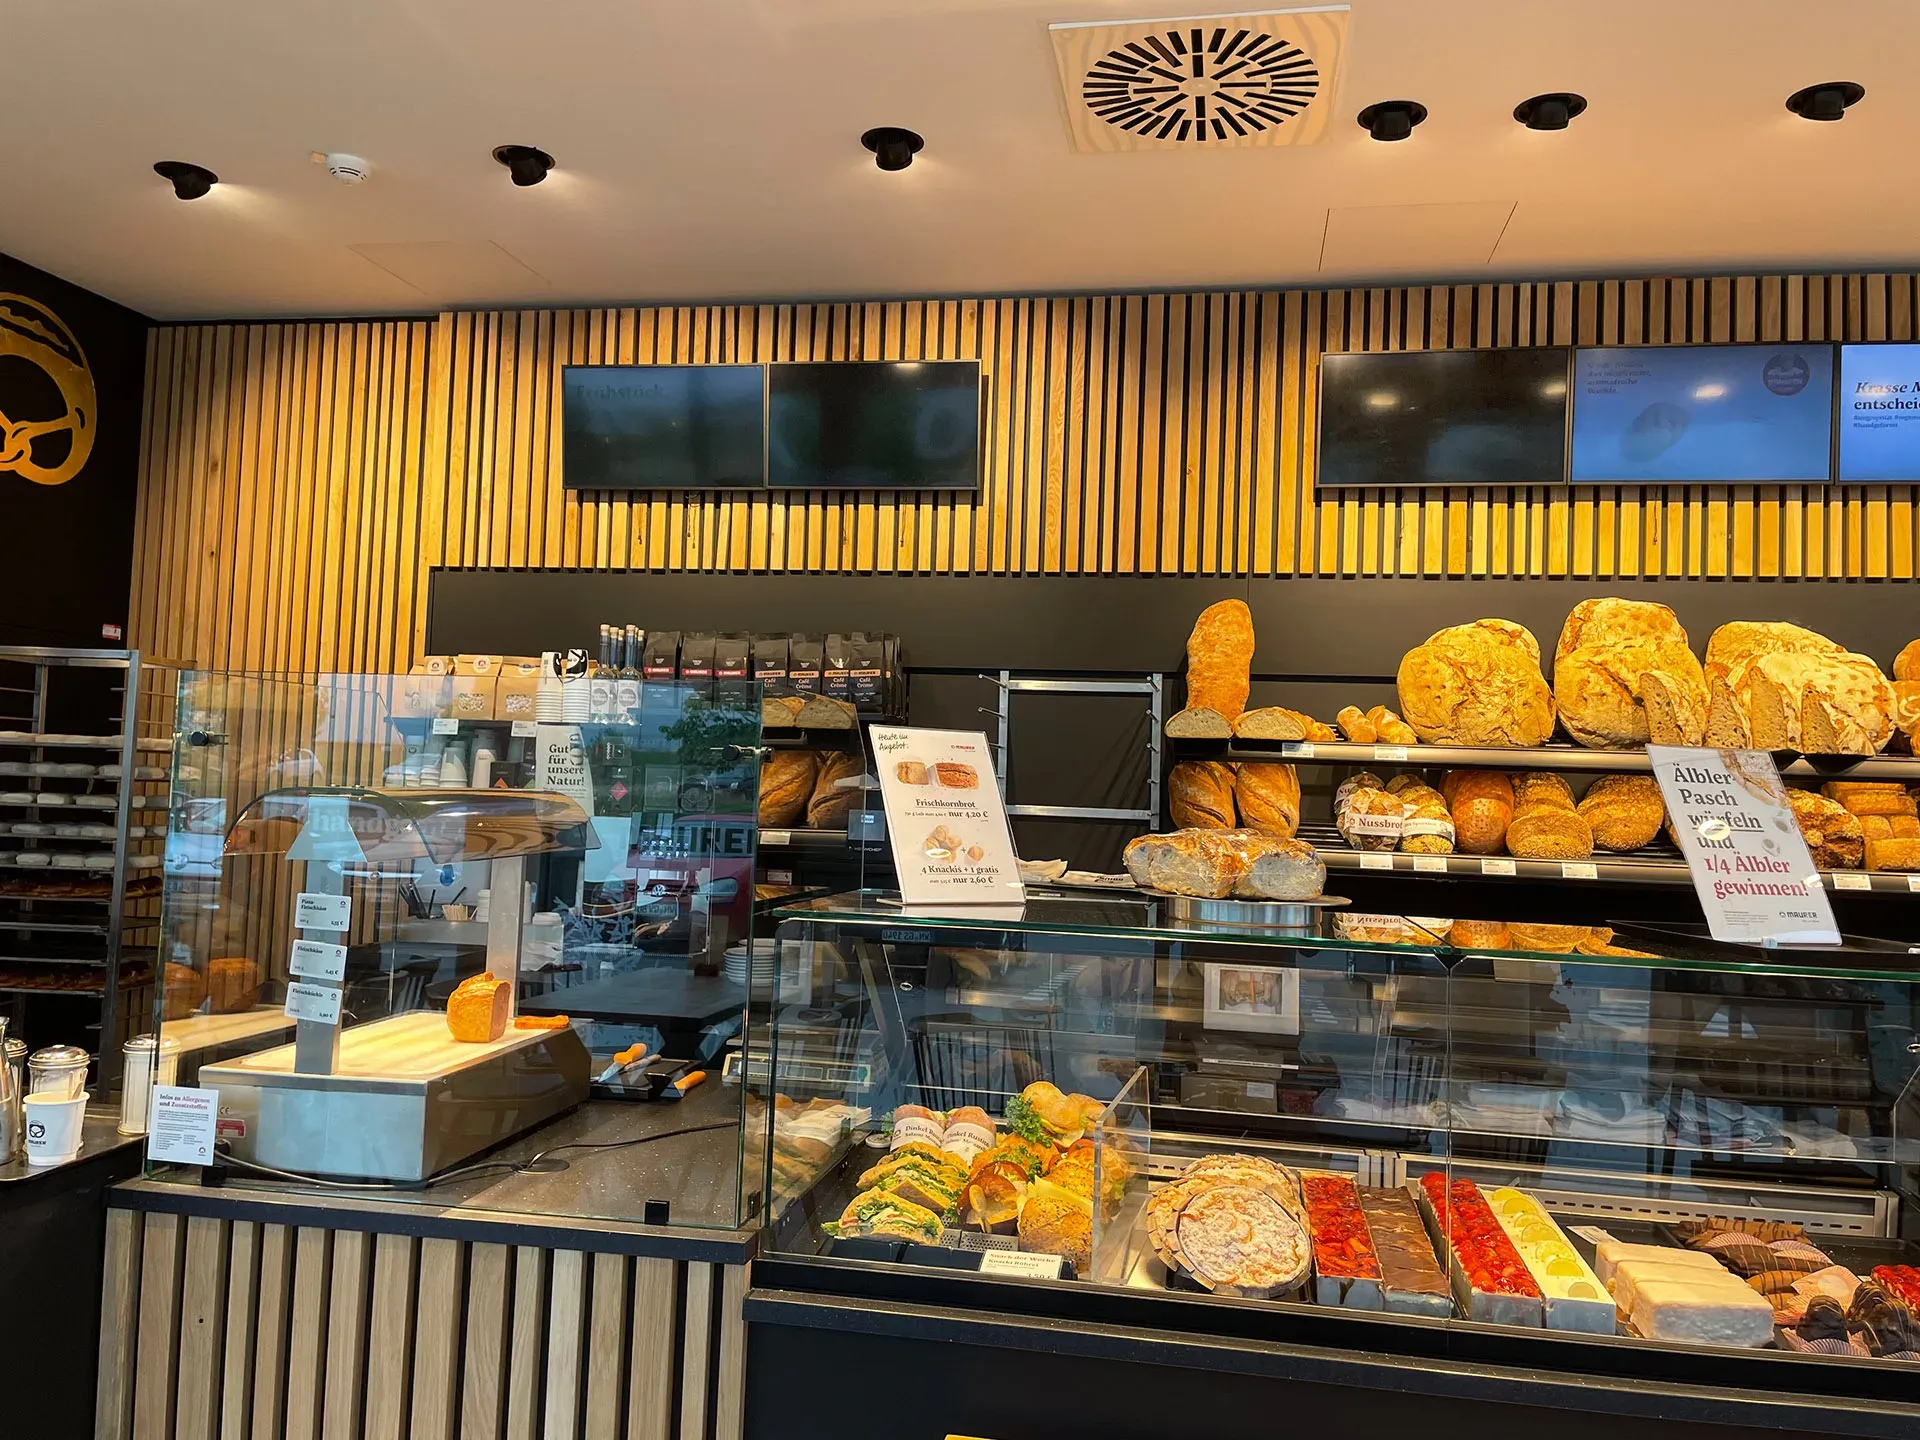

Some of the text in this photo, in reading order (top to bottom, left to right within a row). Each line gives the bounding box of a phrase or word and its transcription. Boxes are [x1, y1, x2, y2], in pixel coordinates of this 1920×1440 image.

[1855, 382, 1908, 394] Krasse
[1854, 397, 1920, 410] entschei
[549, 743, 569, 754] Gut
[548, 754, 567, 765] für
[547, 766, 584, 775] unsere
[547, 776, 585, 786] Natur!
[1678, 788, 1738, 806] Pasch
[915, 799, 976, 808] Frischkornbrot
[965, 811, 981, 819] 4,20
[982, 810, 989, 818] €
[1704, 851, 1791, 875] 1/4 Älbler
[928, 865, 962, 873] Knackis
[976, 865, 999, 875] gratis
[969, 876, 986, 884] 2,60
[988, 876, 994, 884] €
[1713, 878, 1809, 900] gewinnen!
[1786, 911, 1818, 919] MAURER
